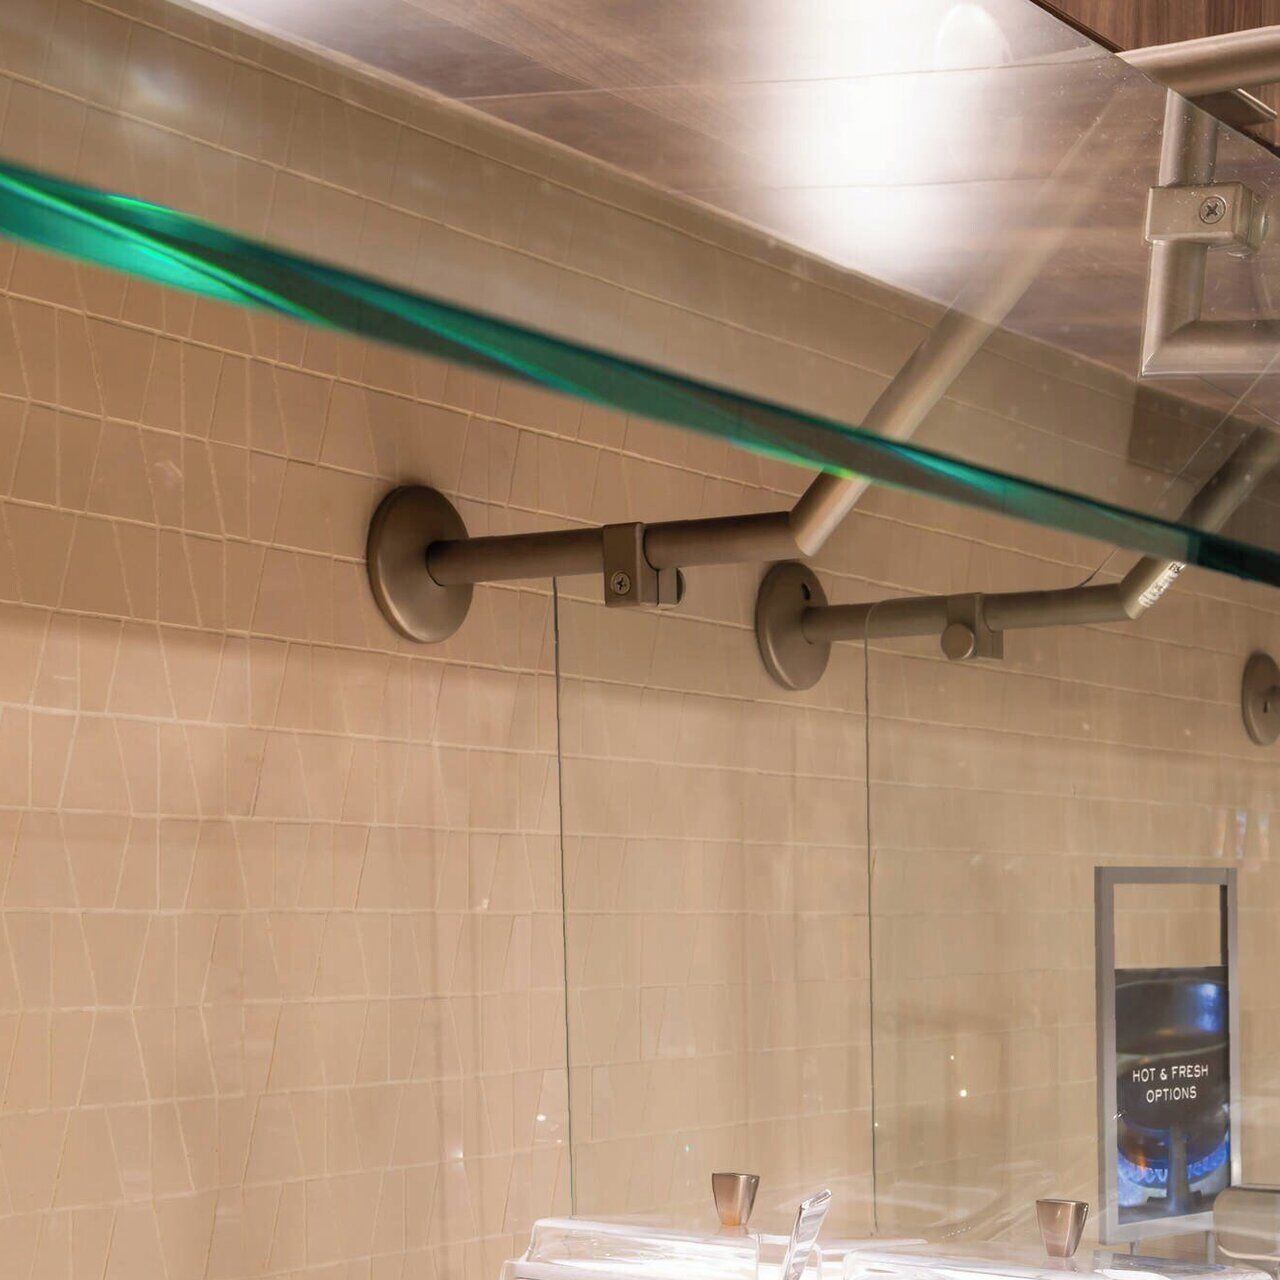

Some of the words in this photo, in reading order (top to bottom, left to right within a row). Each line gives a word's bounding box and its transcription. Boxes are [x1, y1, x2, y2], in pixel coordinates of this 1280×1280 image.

[1133, 1067, 1156, 1082] HOT
[1160, 1068, 1167, 1080] &
[1171, 1064, 1209, 1079] FRESH
[1146, 1085, 1197, 1103] OPTIONS
